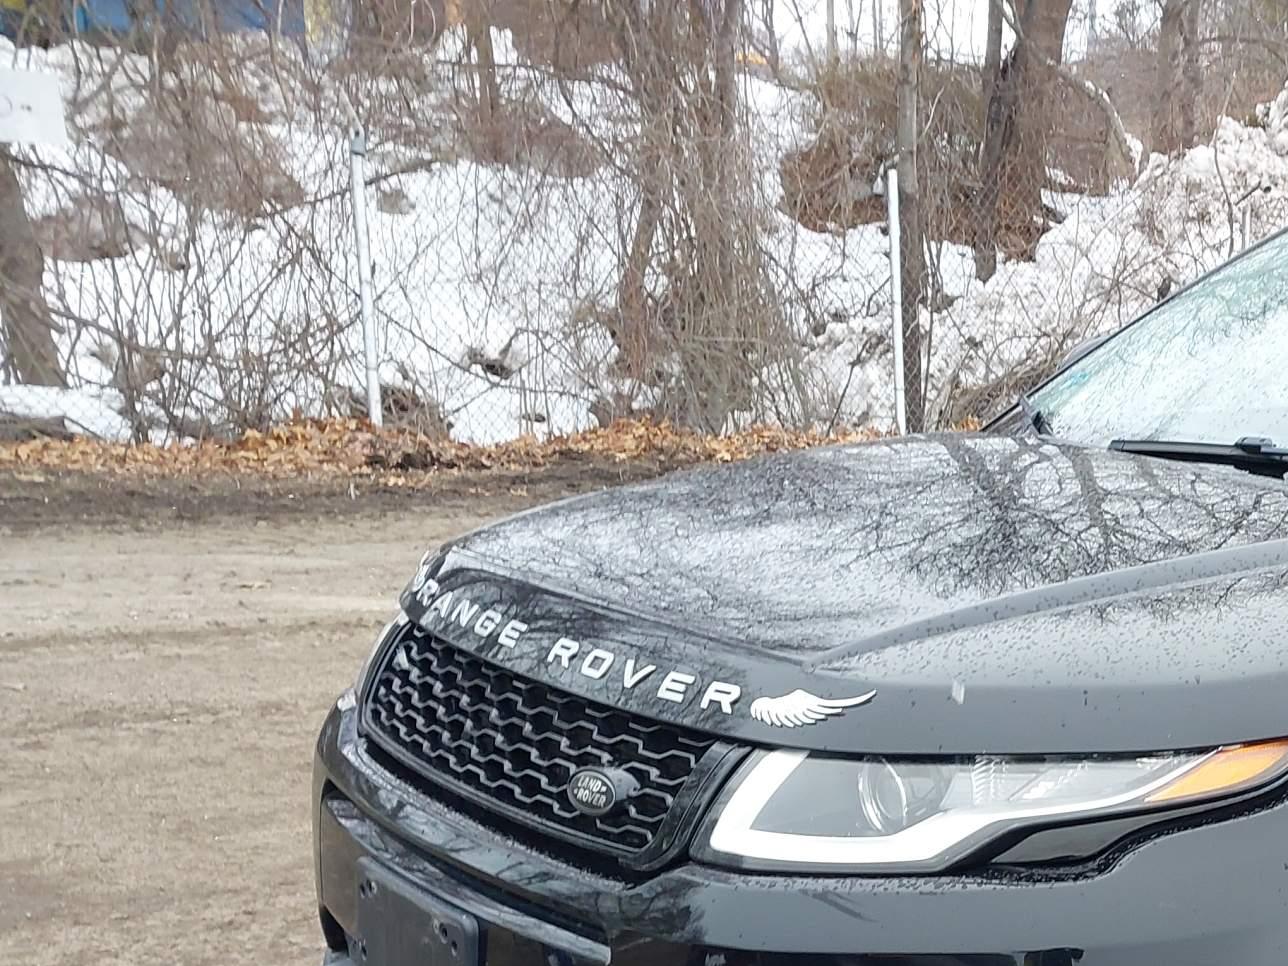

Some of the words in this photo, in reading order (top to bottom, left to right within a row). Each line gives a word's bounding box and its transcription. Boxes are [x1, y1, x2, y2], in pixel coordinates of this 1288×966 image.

[416, 578, 529, 649] RANGE
[547, 637, 741, 715] ROVER
[578, 775, 602, 793] LAND
[577, 788, 607, 808] ROVER
